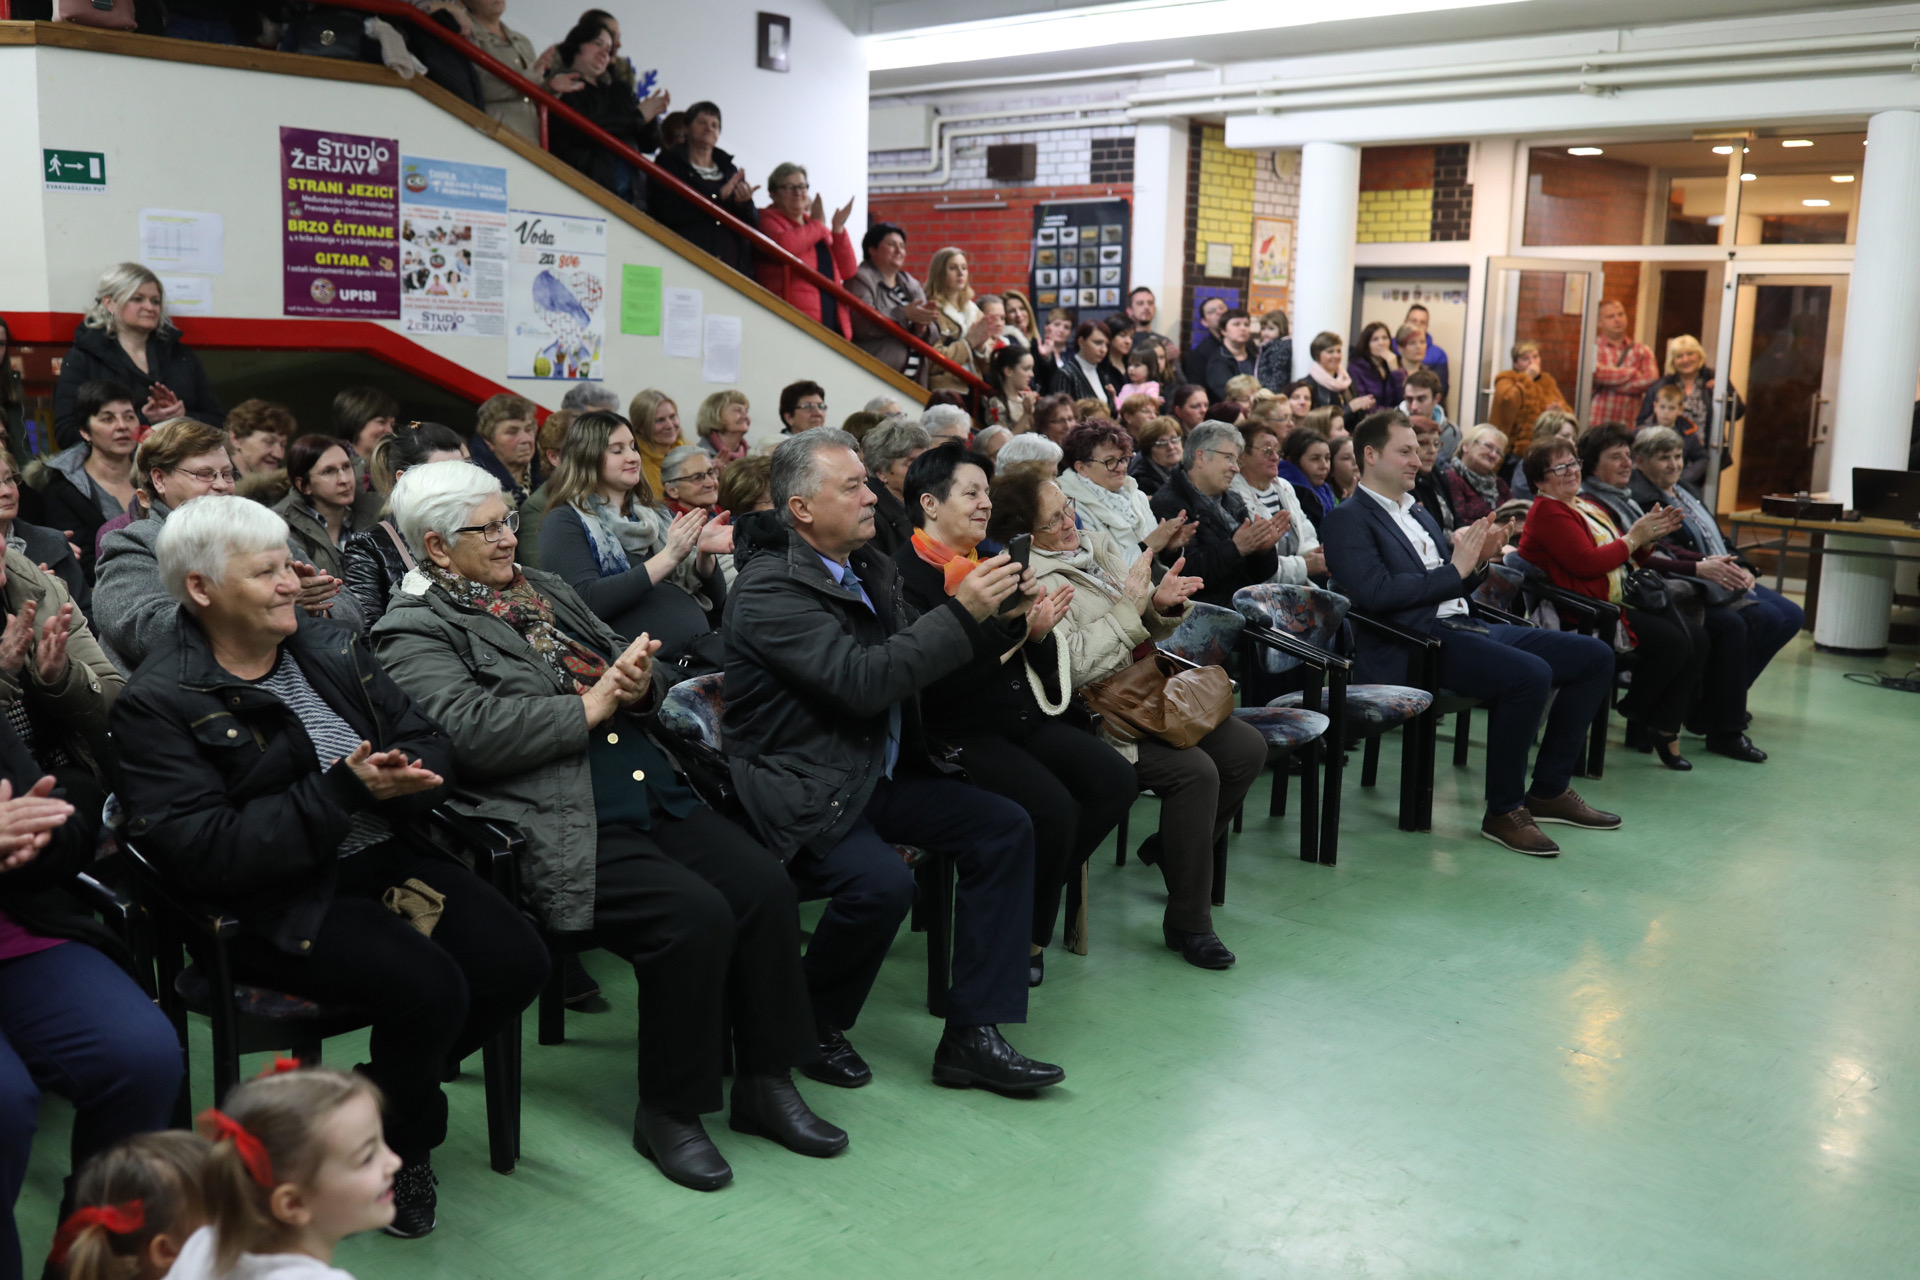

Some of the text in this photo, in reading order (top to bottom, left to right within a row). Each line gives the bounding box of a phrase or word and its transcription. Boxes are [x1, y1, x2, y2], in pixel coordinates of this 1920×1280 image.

[317, 138, 389, 163] STUDIO
[290, 148, 365, 175] ŽERJAV
[288, 177, 394, 199] STRANI JEZICI
[288, 219, 394, 239] BRZO ČITANJE
[514, 218, 555, 246] Voda
[315, 252, 370, 267] GITARA
[539, 252, 555, 265] za
[339, 289, 377, 302] UPISI
[422, 311, 465, 323] STUDIO
